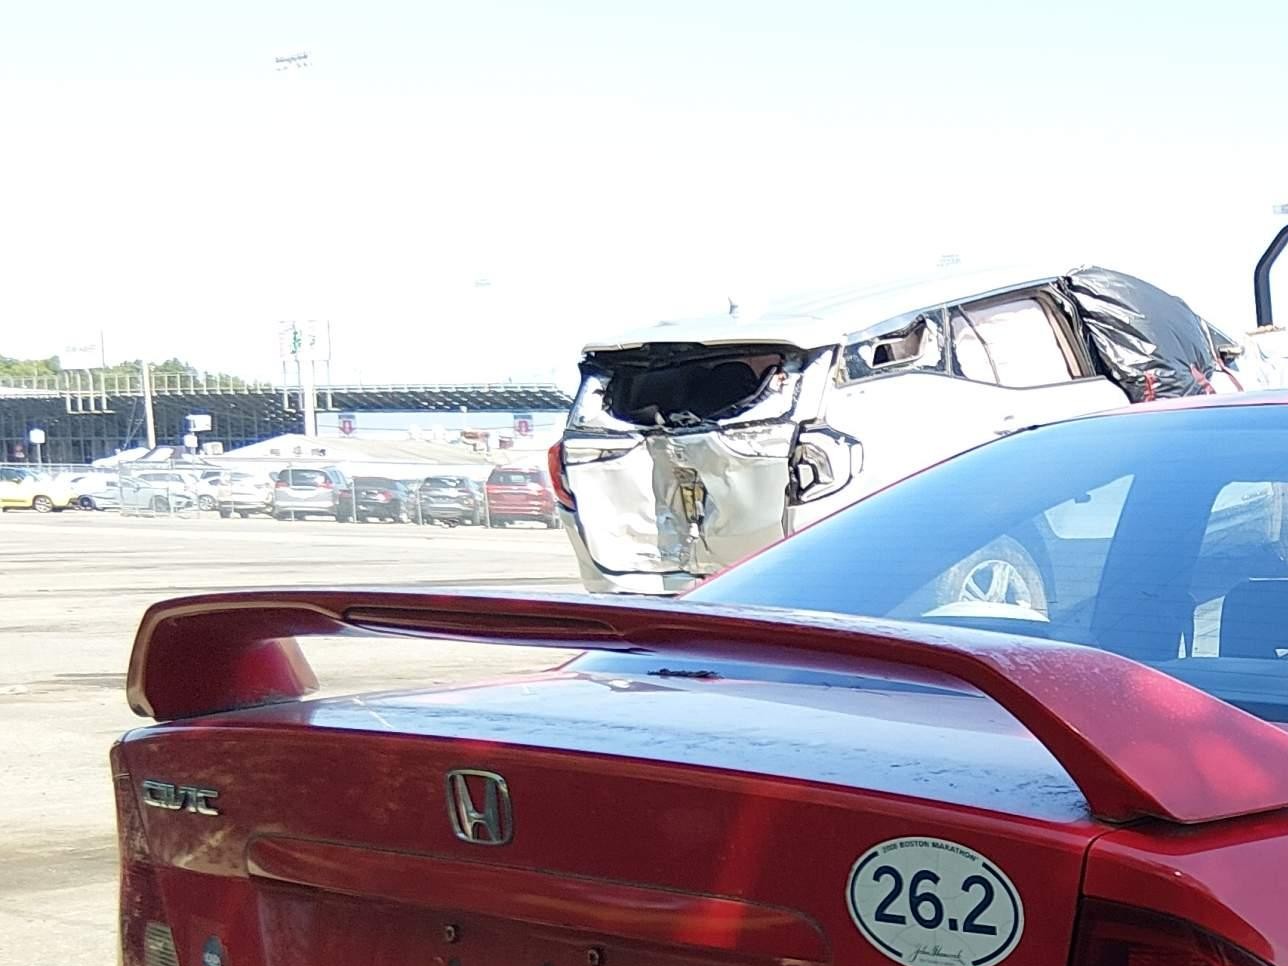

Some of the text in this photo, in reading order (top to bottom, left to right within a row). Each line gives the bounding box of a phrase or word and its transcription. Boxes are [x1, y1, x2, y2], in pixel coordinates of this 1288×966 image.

[899, 841, 930, 849] BOSTON
[932, 842, 977, 861] MARATHON
[873, 865, 997, 936] 26.2
